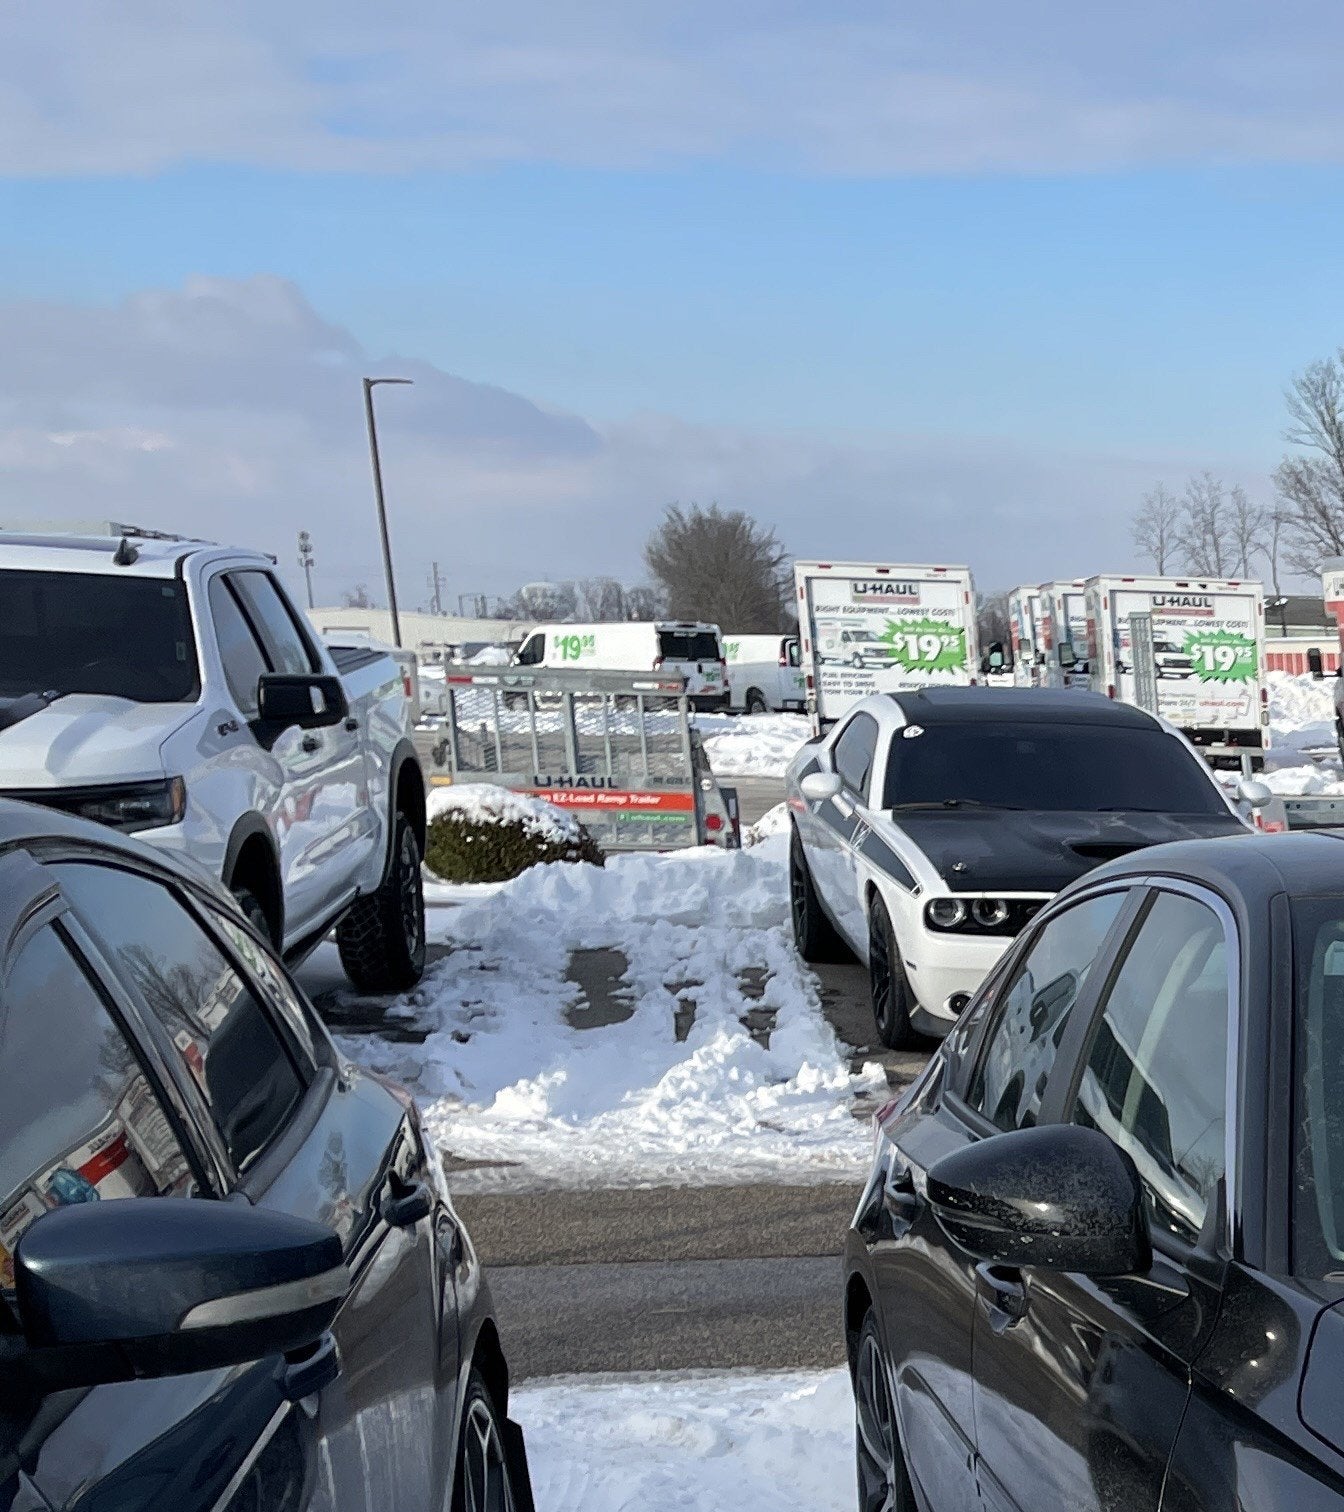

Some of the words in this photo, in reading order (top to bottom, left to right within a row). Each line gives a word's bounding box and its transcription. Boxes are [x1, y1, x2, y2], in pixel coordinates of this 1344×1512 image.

[853, 582, 918, 596] U-HAUL
[1153, 595, 1212, 608] U-HAUL
[534, 775, 618, 789] U-HAUL
[629, 794, 661, 805] Trailer
